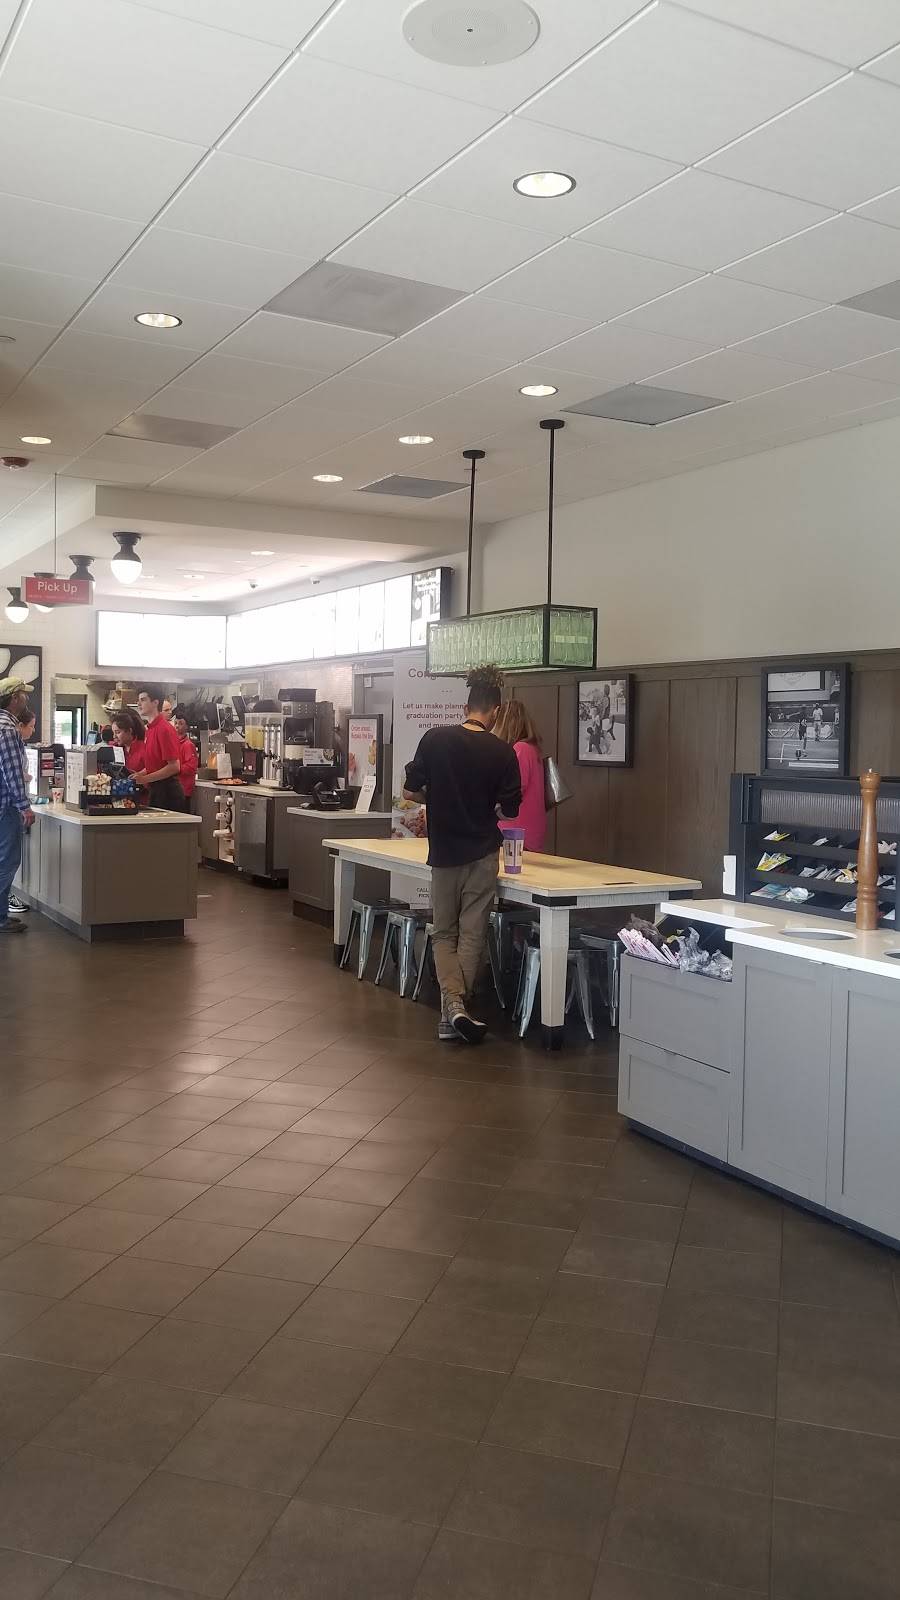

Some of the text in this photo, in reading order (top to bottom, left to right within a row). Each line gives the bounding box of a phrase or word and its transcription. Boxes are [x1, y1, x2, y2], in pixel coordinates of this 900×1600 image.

[37, 581, 78, 594] Pick Up
[406, 712, 463, 720] graduation party
